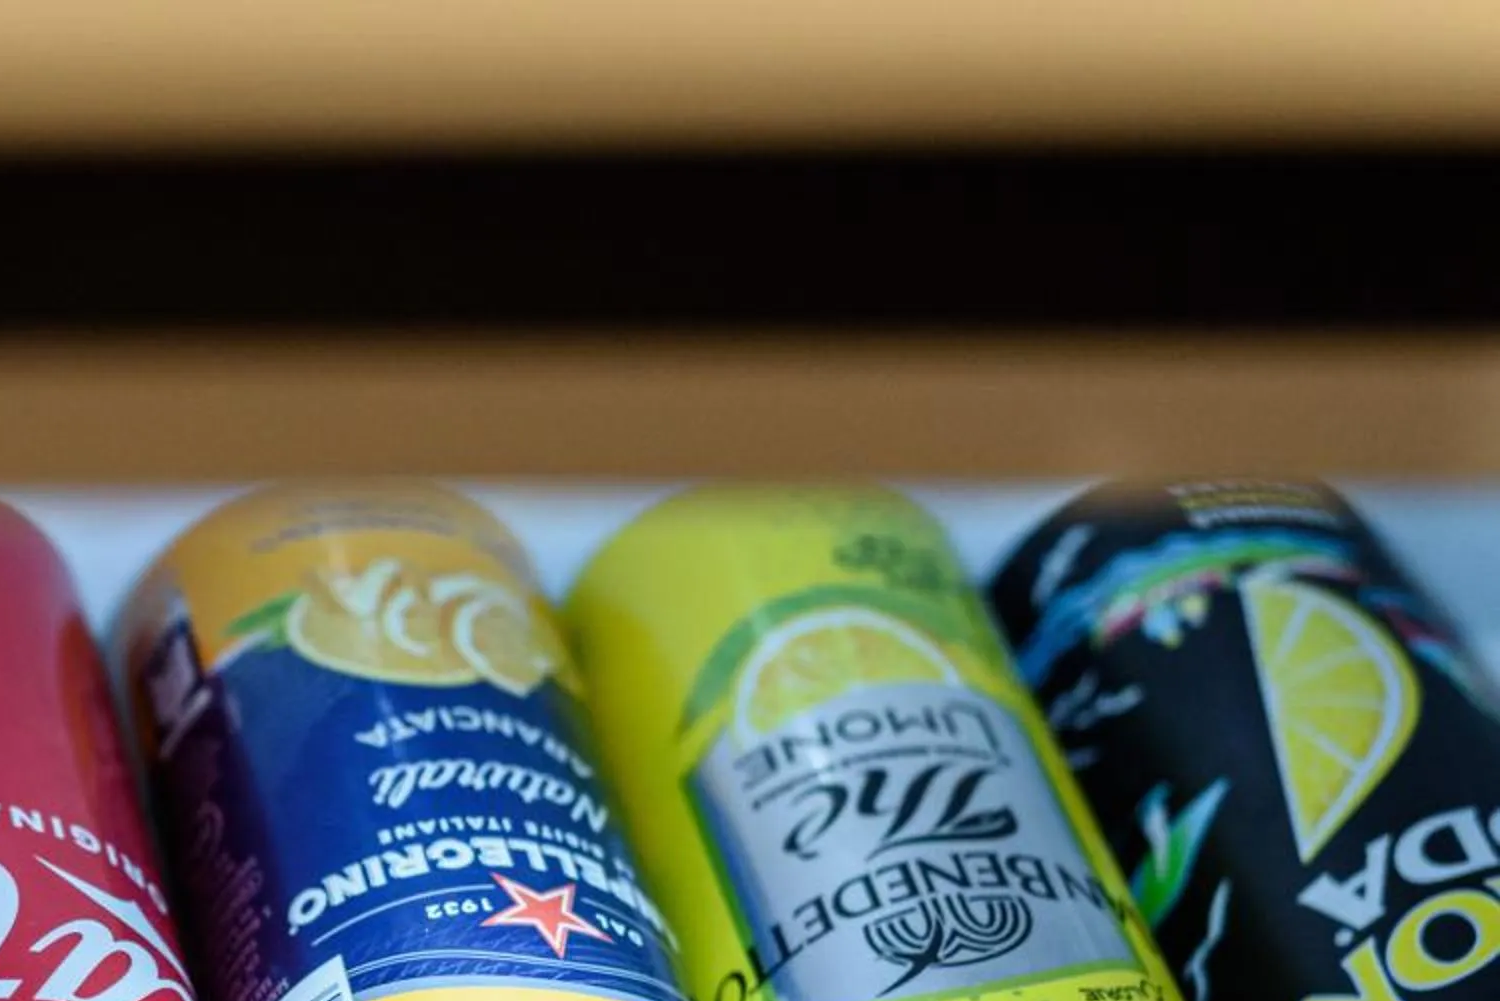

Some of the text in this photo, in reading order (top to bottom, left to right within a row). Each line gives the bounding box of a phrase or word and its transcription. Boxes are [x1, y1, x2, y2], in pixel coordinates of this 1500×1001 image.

[354, 705, 594, 779] ARANCIATA
[733, 703, 1002, 788] LIMONE
[367, 758, 609, 833] Naturali
[376, 814, 512, 846] ITALIANE
[1296, 805, 1500, 933] DA
[423, 896, 494, 921] 1932
